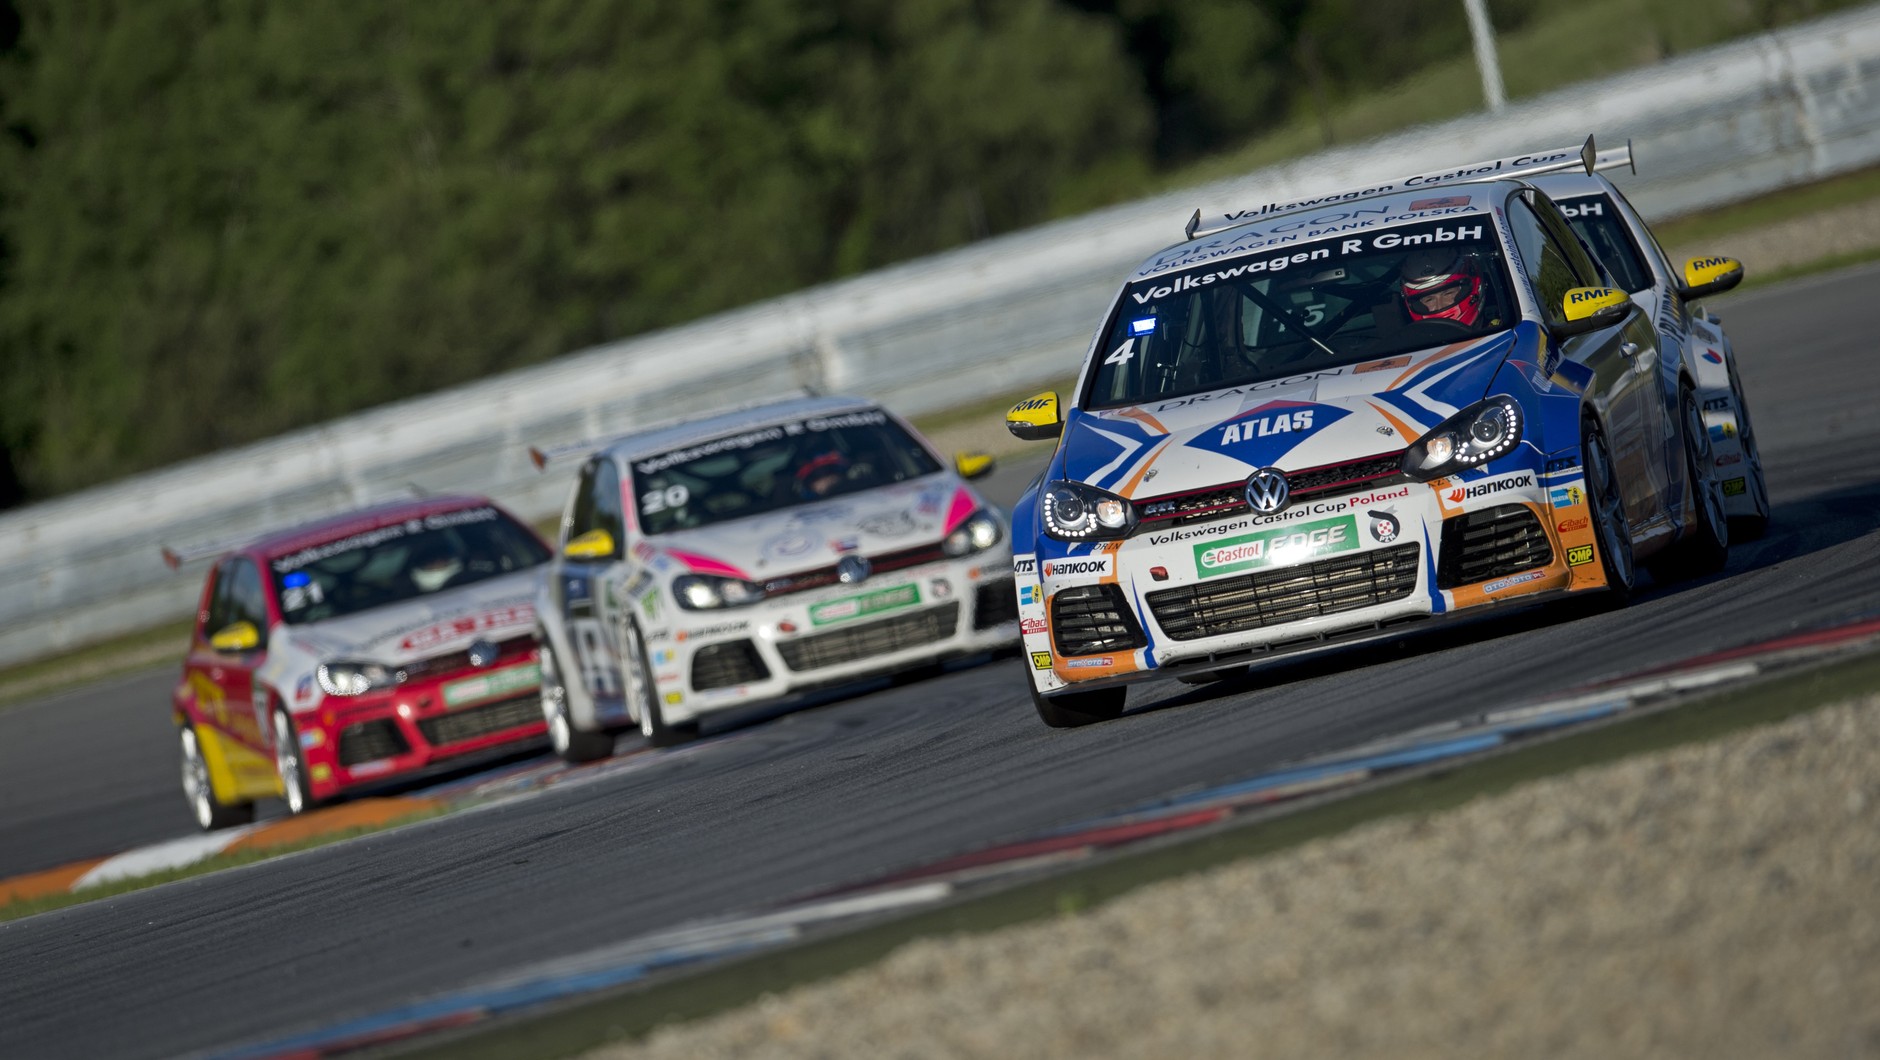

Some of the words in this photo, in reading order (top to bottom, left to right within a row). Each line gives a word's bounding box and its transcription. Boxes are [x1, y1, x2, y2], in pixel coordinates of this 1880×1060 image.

[1224, 185, 1394, 221] Volkswagen
[1404, 160, 1501, 187] Castrol
[1512, 152, 1567, 167] Cup
[1560, 202, 1604, 217] bH
[1138, 234, 1298, 277] VOLKSWAGEN
[1307, 219, 1375, 238] BANK
[1384, 205, 1479, 223] POLSKA
[1154, 205, 1390, 267] DRAGON
[1132, 248, 1330, 305] Volkswagen
[1341, 239, 1363, 255] R
[1372, 225, 1483, 249] GmbH
[1692, 256, 1732, 272] RMF
[1570, 288, 1614, 304] RMF
[1104, 338, 1135, 366] 4
[1157, 368, 1343, 413] DRAGON
[1011, 398, 1054, 414] RMF
[1220, 409, 1314, 446] ATLAS
[641, 484, 690, 515] 20
[1150, 520, 1248, 546] Volkswagen
[1252, 506, 1311, 526] Castrol
[1313, 503, 1347, 516] Cup
[1349, 487, 1410, 508] Poland
[1014, 558, 1036, 573] ATS
[1215, 543, 1261, 565] Castrol
[1568, 548, 1592, 563] OMP
[1033, 655, 1051, 667] OMP
